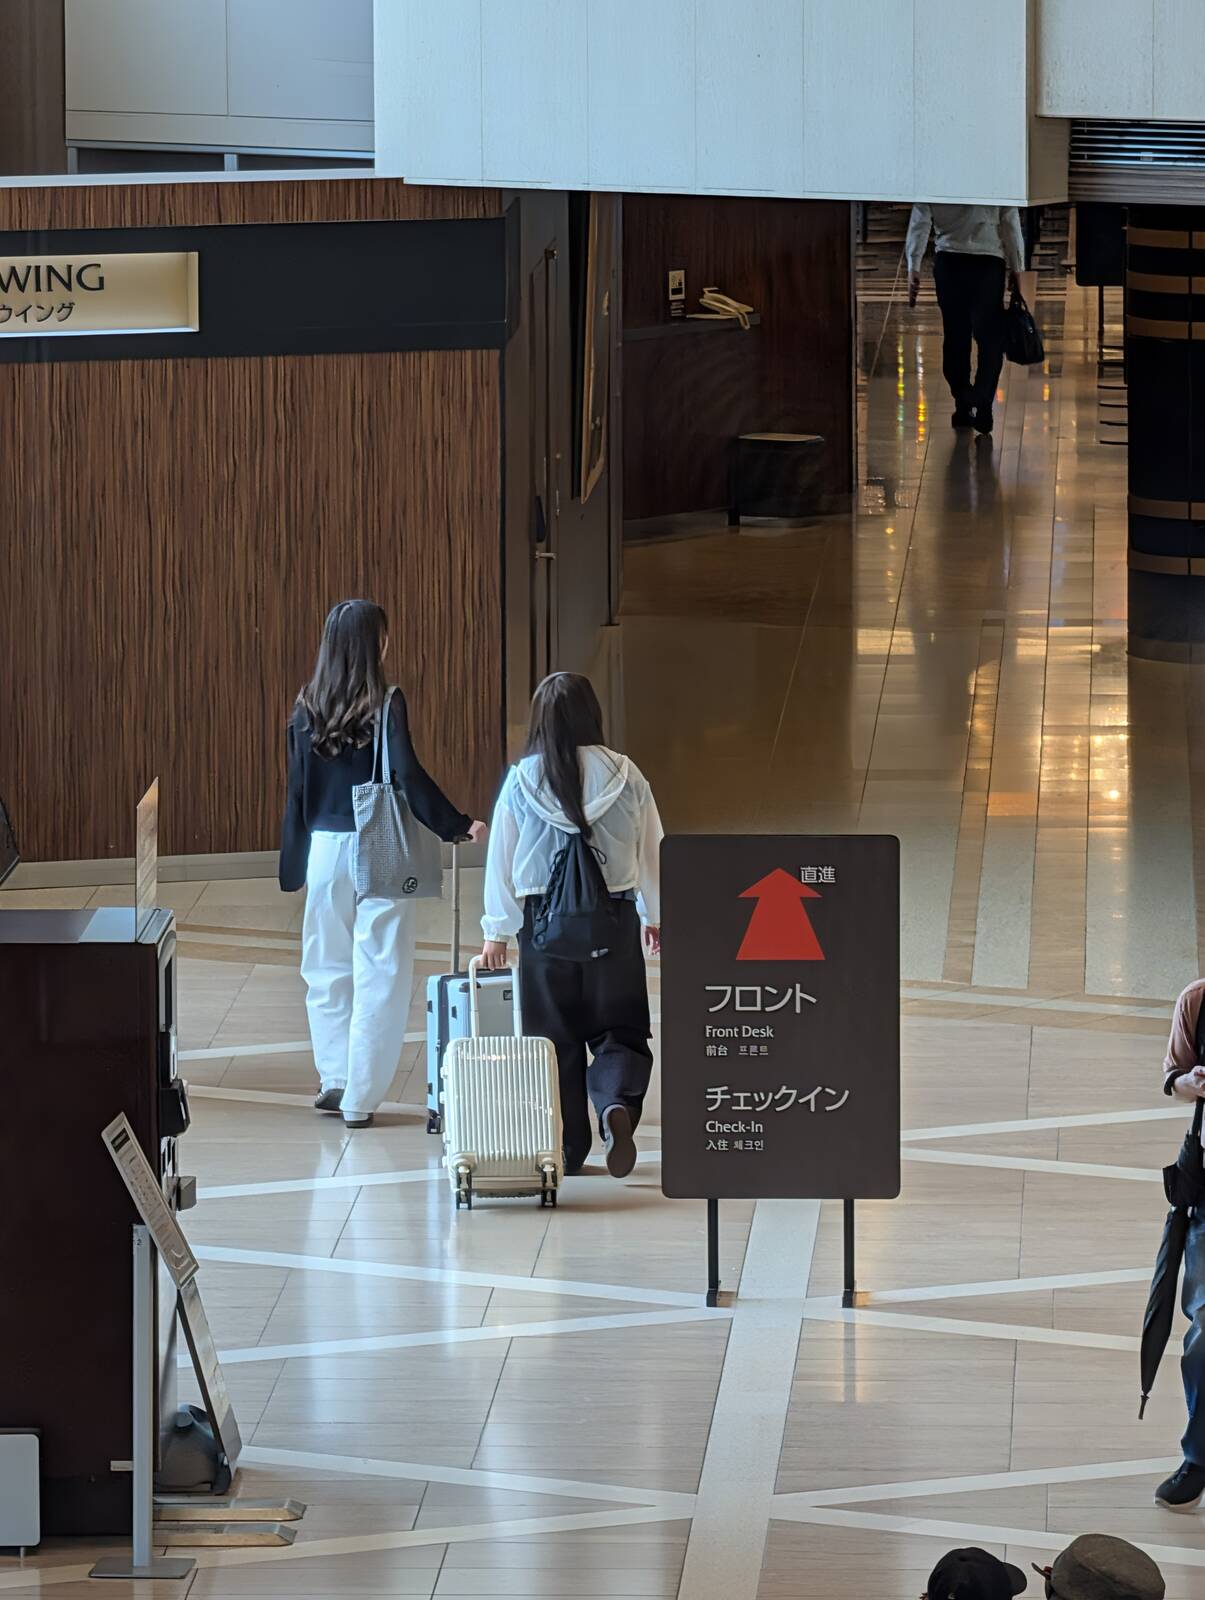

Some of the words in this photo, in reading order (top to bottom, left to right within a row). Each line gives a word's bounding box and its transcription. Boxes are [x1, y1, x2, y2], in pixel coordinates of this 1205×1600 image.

[0, 263, 105, 293] WING
[0, 301, 76, 324] ウイング
[800, 866, 836, 883] 直進
[705, 983, 817, 1014] フロント
[705, 1025, 739, 1038] Front
[742, 1025, 774, 1038] Desk
[705, 1044, 728, 1057] 前台
[705, 1085, 849, 1112] チェックイン
[705, 1120, 763, 1133] Check-In
[705, 1139, 729, 1151] 入住
